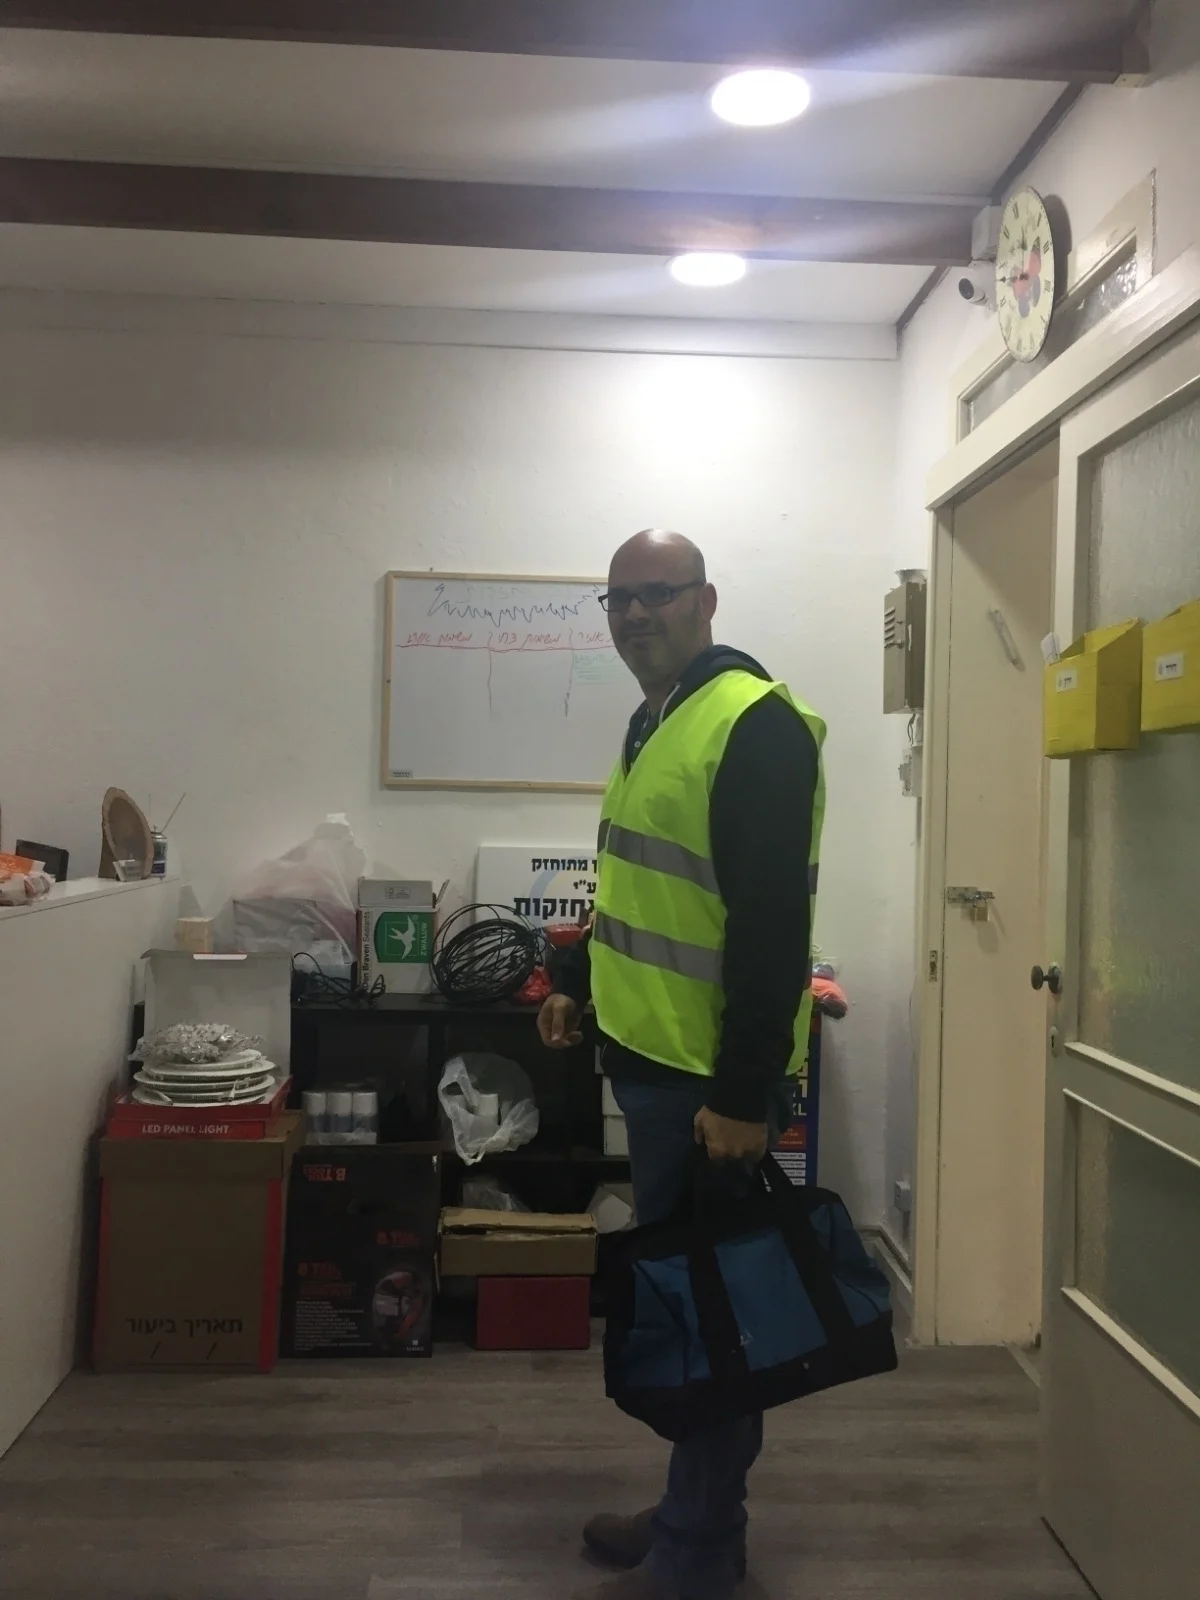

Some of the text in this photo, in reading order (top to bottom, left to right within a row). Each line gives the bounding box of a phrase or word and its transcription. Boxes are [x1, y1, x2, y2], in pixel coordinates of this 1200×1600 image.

[531, 858, 588, 872] מתוחזק
[362, 943, 370, 971] Braven
[142, 1124, 161, 1133] LED
[163, 1124, 196, 1134] PANEL
[125, 1319, 243, 1337] תאריך ביעור
